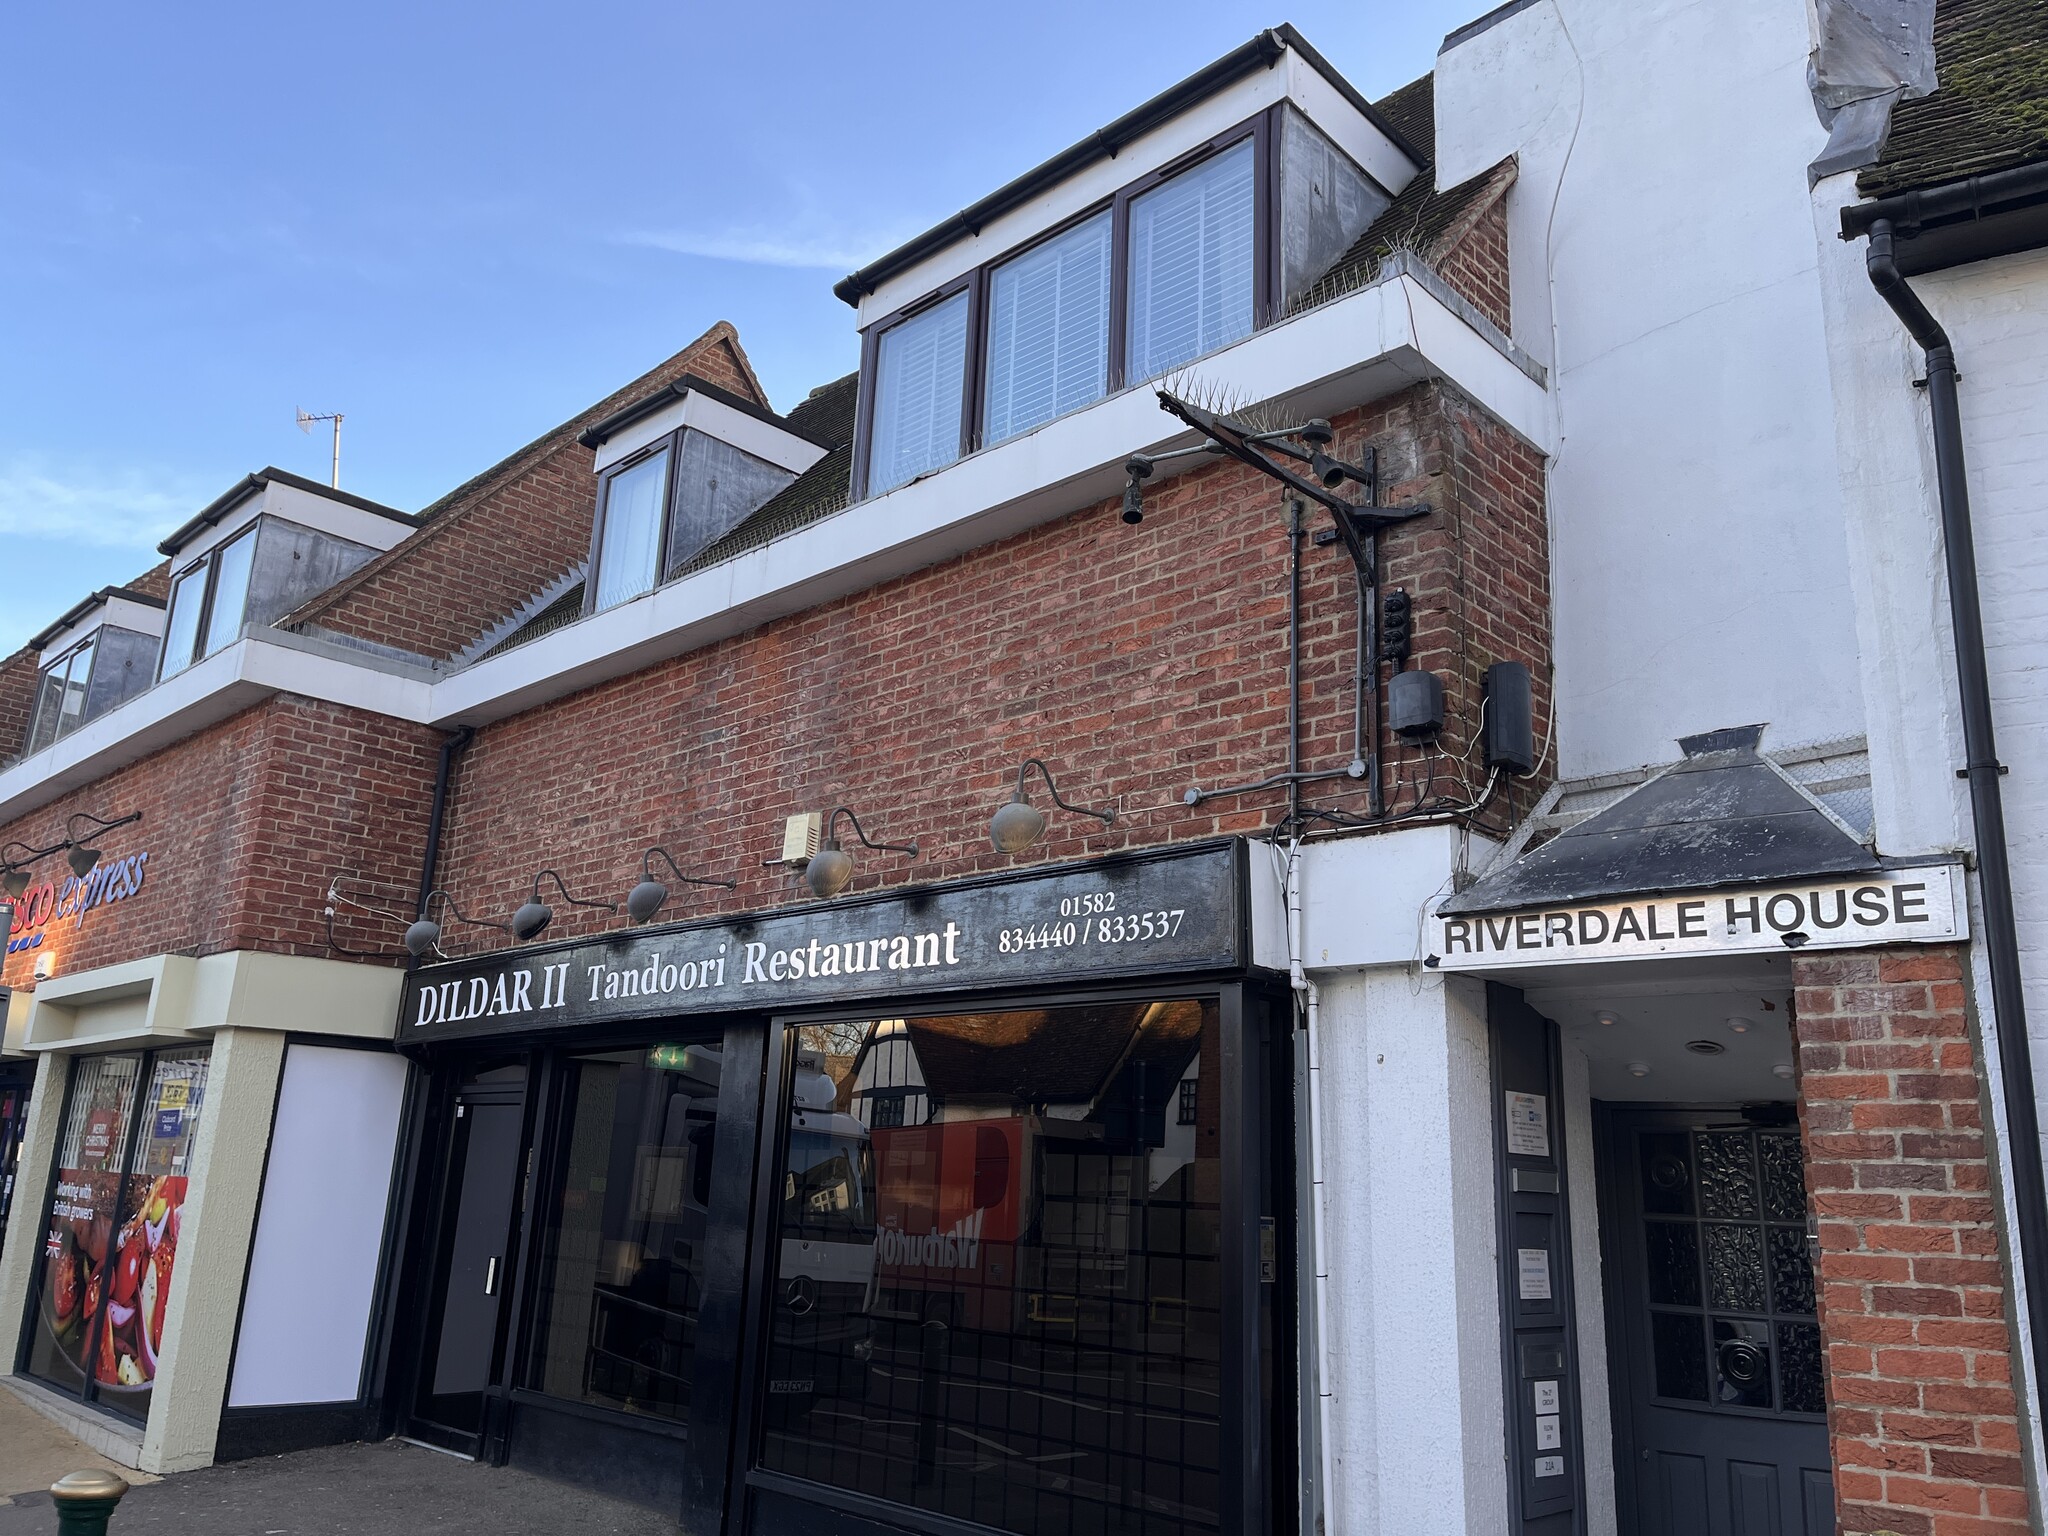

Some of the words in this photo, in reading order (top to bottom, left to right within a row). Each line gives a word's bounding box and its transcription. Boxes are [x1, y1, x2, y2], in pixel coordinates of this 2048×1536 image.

[0, 881, 55, 934] SCO
[56, 851, 149, 929] express
[1060, 891, 1116, 917] 01582
[998, 921, 1077, 954] 834440
[1097, 909, 1185, 943] 833537
[1445, 901, 1709, 955] RIVERDALE
[1726, 882, 1931, 937] HOUSE
[414, 969, 533, 1027] DILDAR
[540, 962, 570, 1010] II
[588, 943, 726, 1002] Tandoori
[742, 921, 961, 984] Restaurant
[85, 1135, 110, 1147] CHRISTMAS
[57, 1181, 79, 1202] Working
[79, 1183, 92, 1199] with
[53, 1200, 71, 1217] British
[69, 1206, 94, 1222] growers
